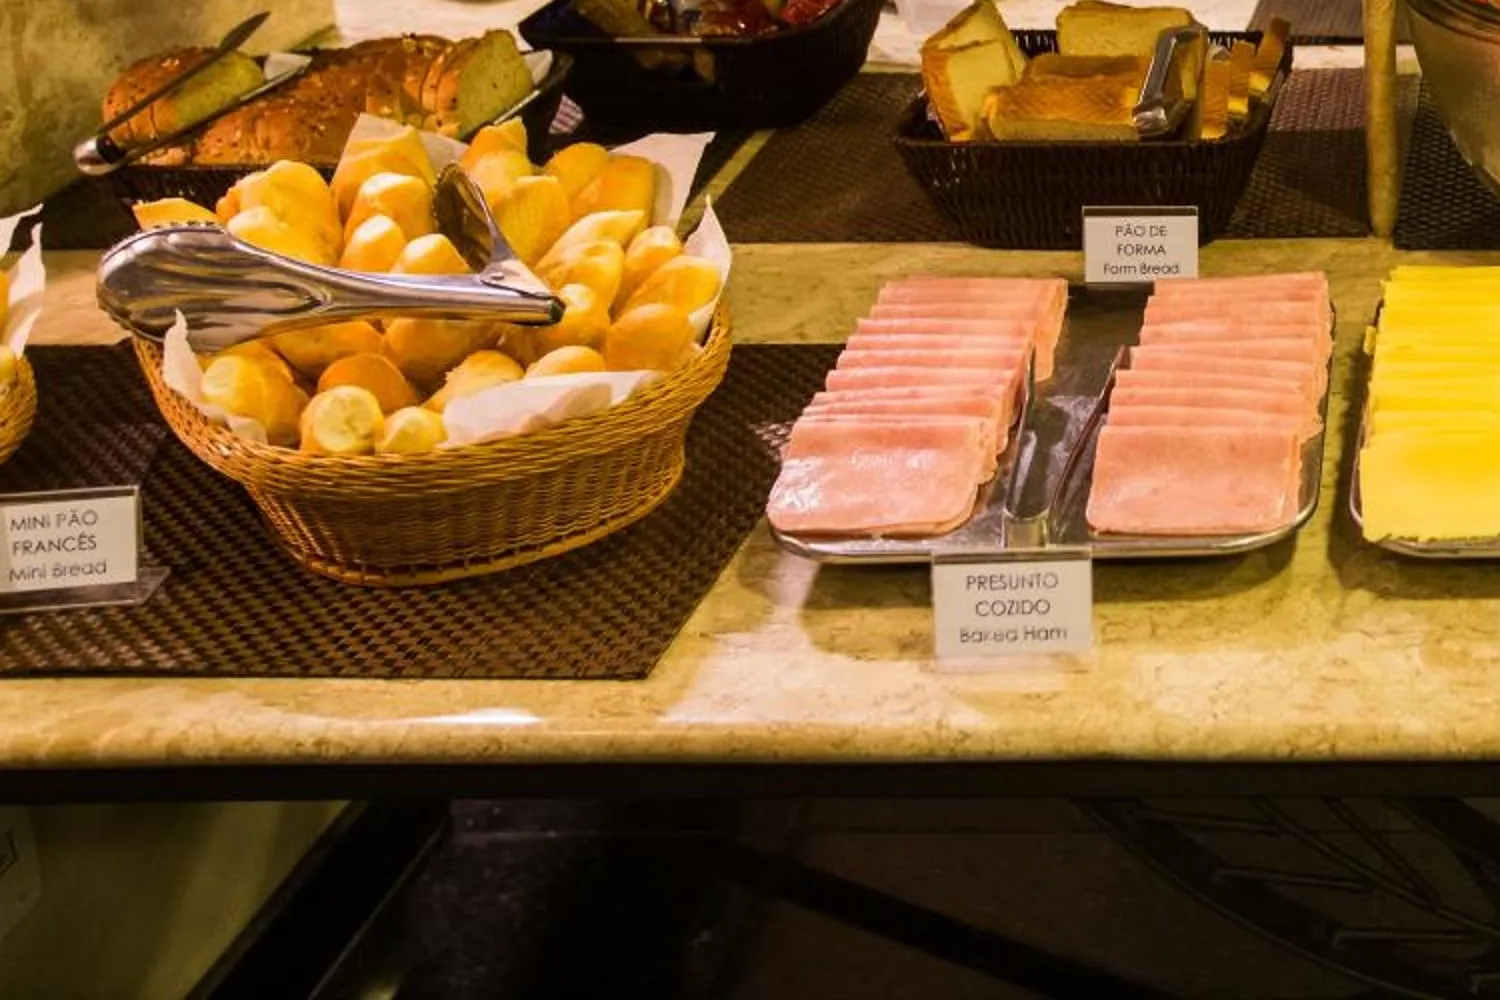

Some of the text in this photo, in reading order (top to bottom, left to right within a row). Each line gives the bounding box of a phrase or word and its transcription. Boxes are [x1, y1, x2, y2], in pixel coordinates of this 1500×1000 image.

[1115, 223, 1167, 237] PÃO DE
[1117, 244, 1166, 256] FORMA
[1140, 262, 1179, 275] Bread
[10, 508, 98, 531] MINI PÃO
[12, 533, 97, 556] FRANCÊS
[9, 559, 107, 581] Mini Bread
[965, 572, 1059, 591] PRESUNTO
[975, 599, 1051, 617] COZIDO
[1023, 625, 1068, 641] Ham
